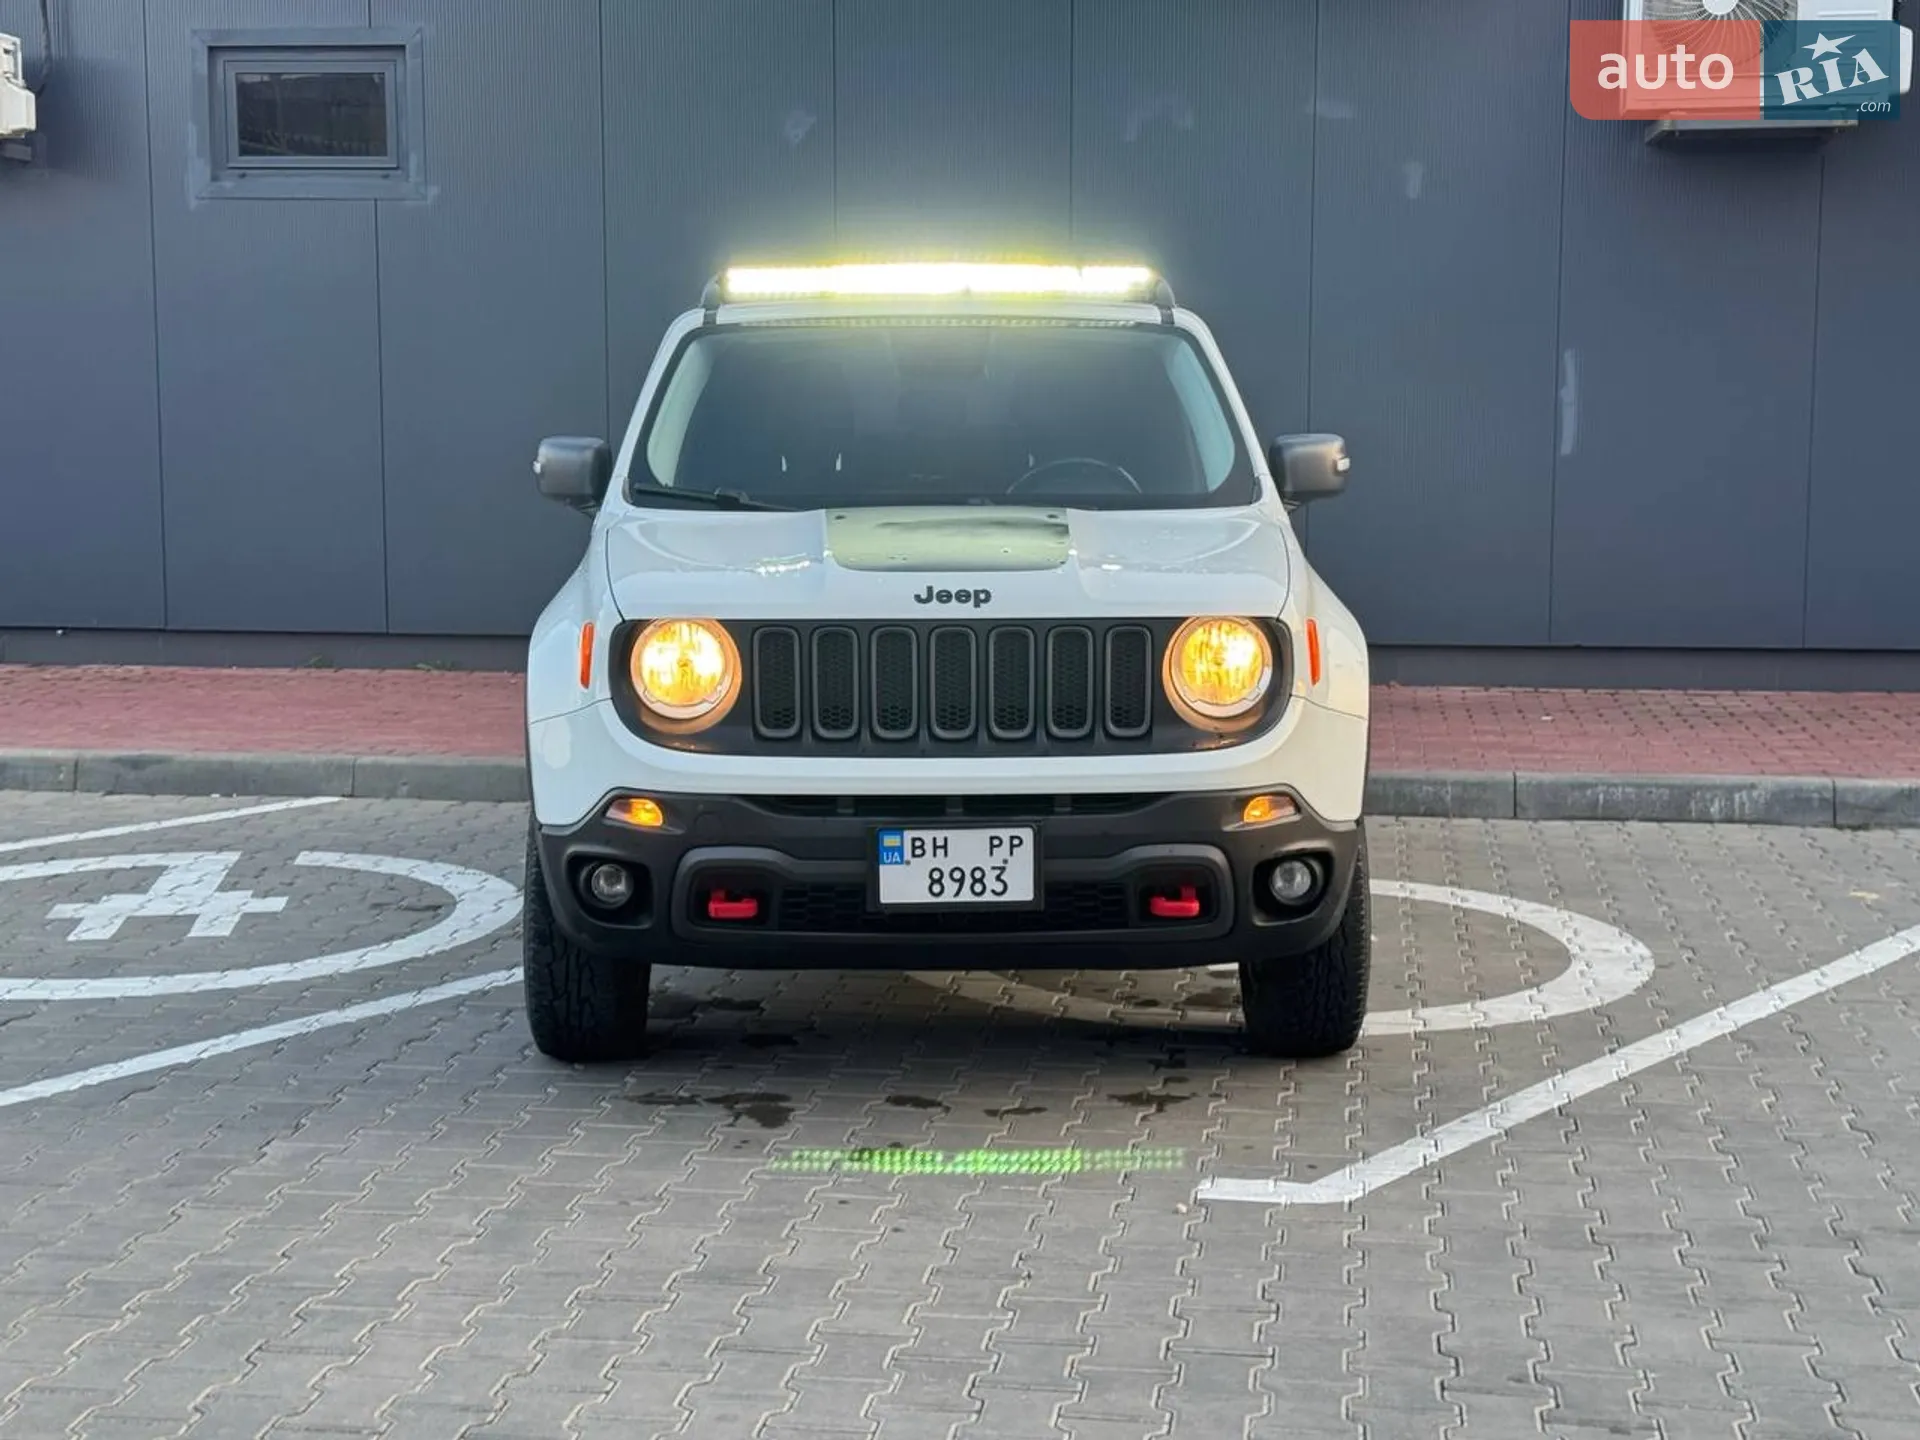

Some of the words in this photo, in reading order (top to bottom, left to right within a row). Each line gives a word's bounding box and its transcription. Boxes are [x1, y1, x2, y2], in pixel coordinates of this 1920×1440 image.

[913, 585, 992, 608] Jeep
[883, 852, 901, 863] UA
[911, 836, 948, 858] BH
[989, 835, 1023, 857] PP
[928, 866, 1008, 898] 8983
